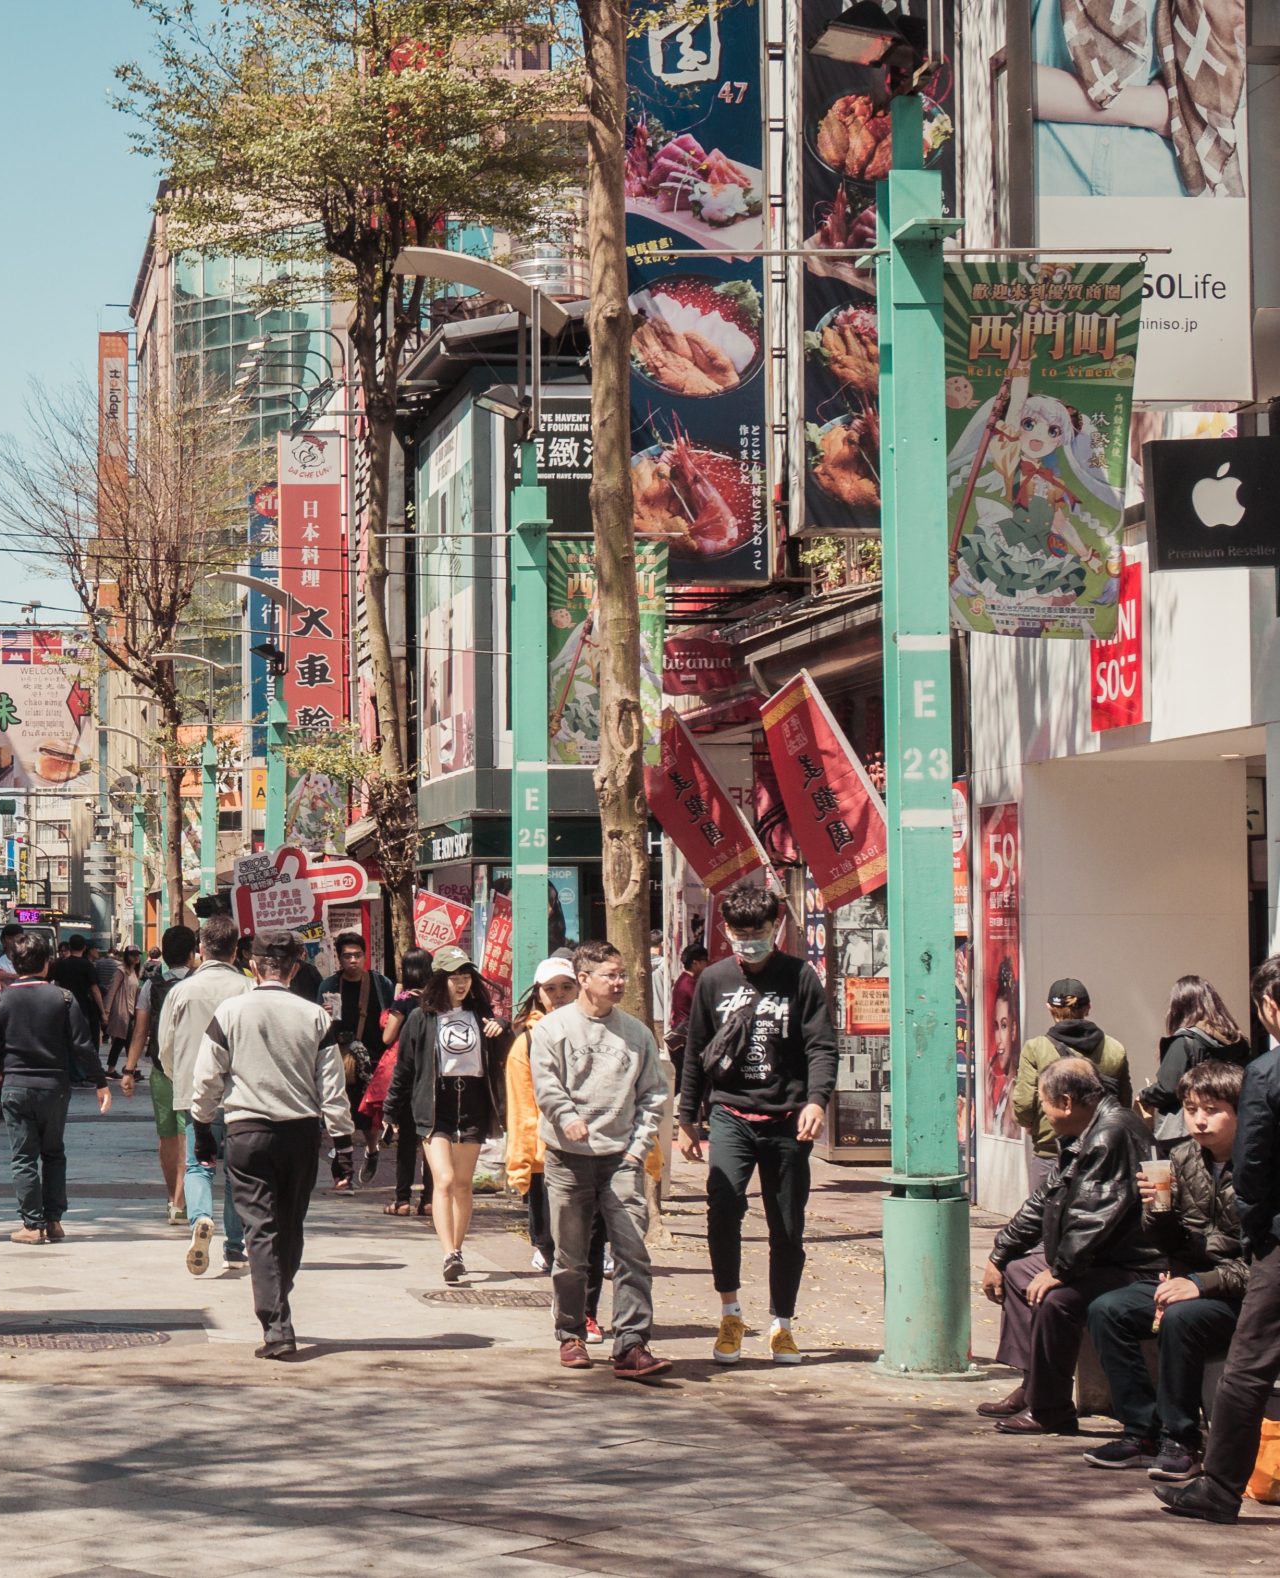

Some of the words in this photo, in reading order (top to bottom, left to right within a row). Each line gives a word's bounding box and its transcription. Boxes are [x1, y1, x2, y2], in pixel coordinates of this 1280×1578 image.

[717, 81, 748, 104] 47
[969, 311, 1121, 360] 西門町
[967, 365, 1029, 377] Welcome
[1041, 366, 1057, 377] to
[1067, 365, 1113, 377] Ximen
[103, 369, 121, 420] Holiday
[547, 424, 588, 432] FOUNTAIN
[555, 414, 590, 422] HAVEN'T
[301, 500, 320, 587] 日本料理
[1168, 549, 1224, 561] Premium
[1228, 545, 1276, 558] Reseller
[21, 667, 67, 675] WELCOME
[293, 606, 335, 731] 大車輪
[913, 680, 936, 718] E
[903, 748, 949, 781] 23
[525, 788, 539, 811] E
[432, 838, 442, 861] THE
[442, 836, 455, 859] BODY
[455, 833, 468, 857] SHOP
[519, 828, 546, 848] 25
[741, 1064, 771, 1072] LONDON
